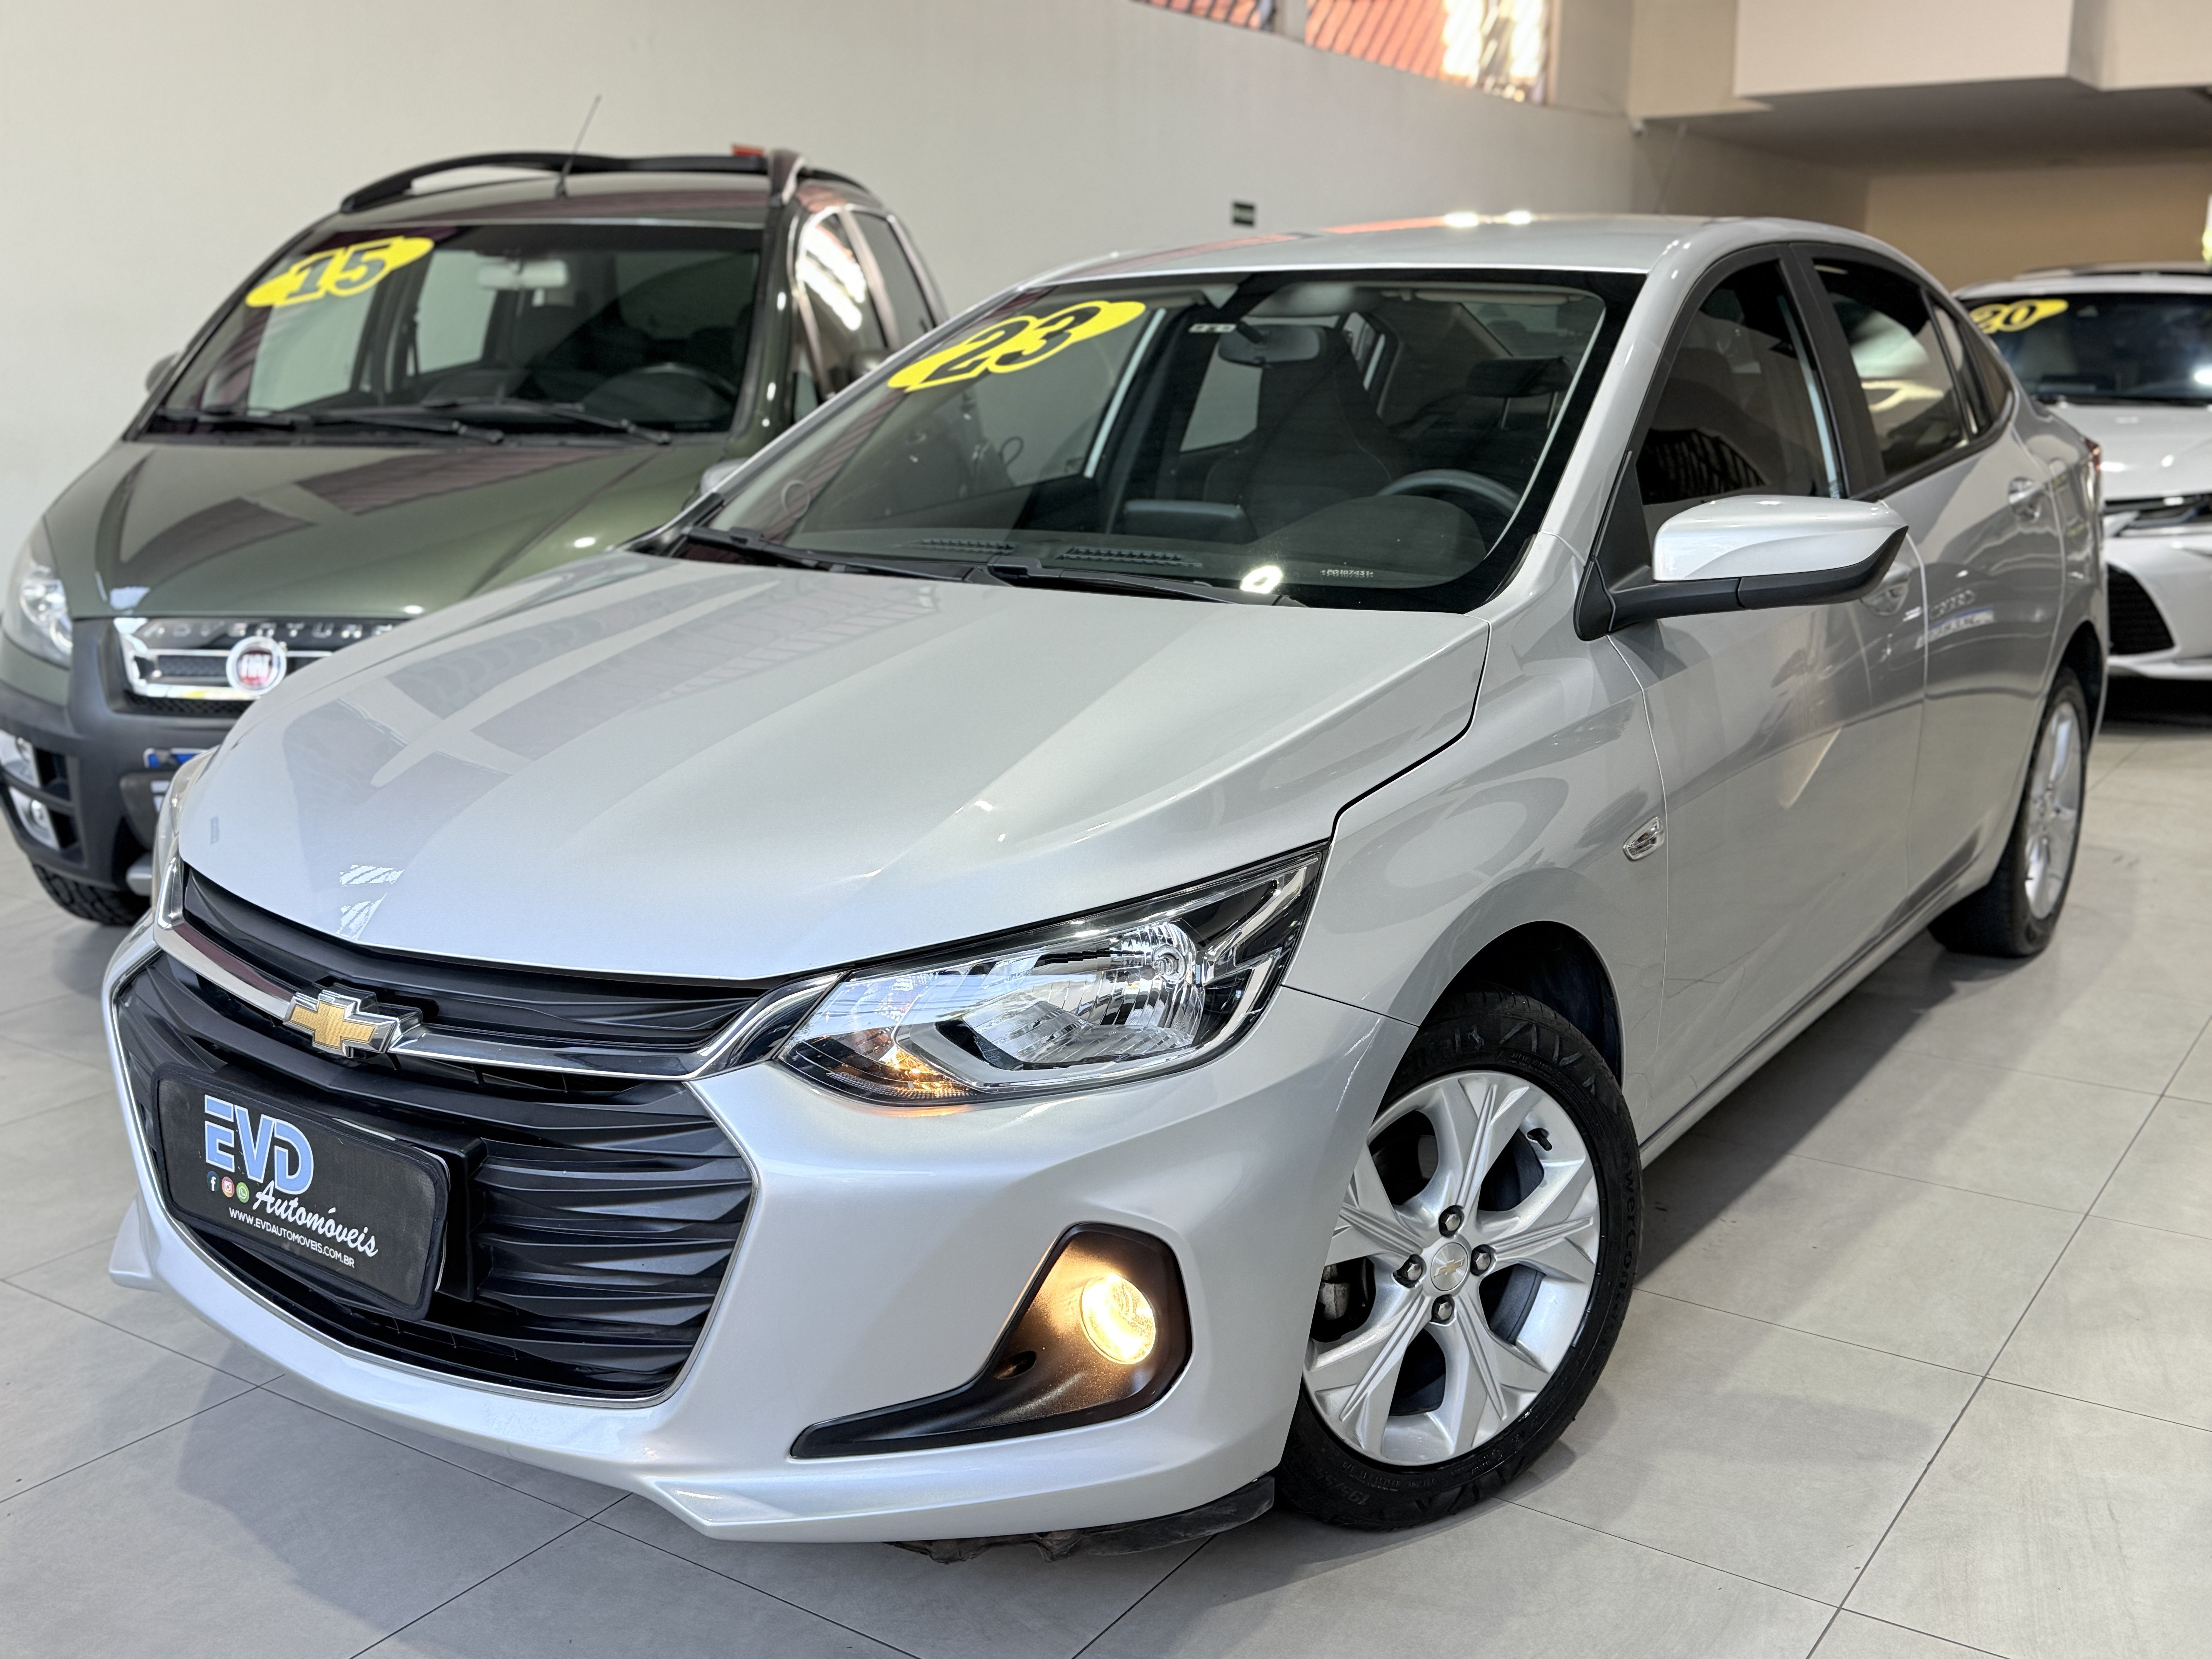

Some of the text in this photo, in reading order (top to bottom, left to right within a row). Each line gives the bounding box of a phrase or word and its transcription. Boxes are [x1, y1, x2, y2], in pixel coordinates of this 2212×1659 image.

[282, 239, 397, 302] 15
[915, 303, 1106, 388] 23
[1971, 301, 2038, 332] 20
[239, 654, 271, 678] FIAT
[204, 1094, 314, 1195] EVD
[229, 1207, 356, 1268] WWW.EVDAUTOMOVEIS.COM.BR
[252, 1180, 378, 1257] Automóveis
